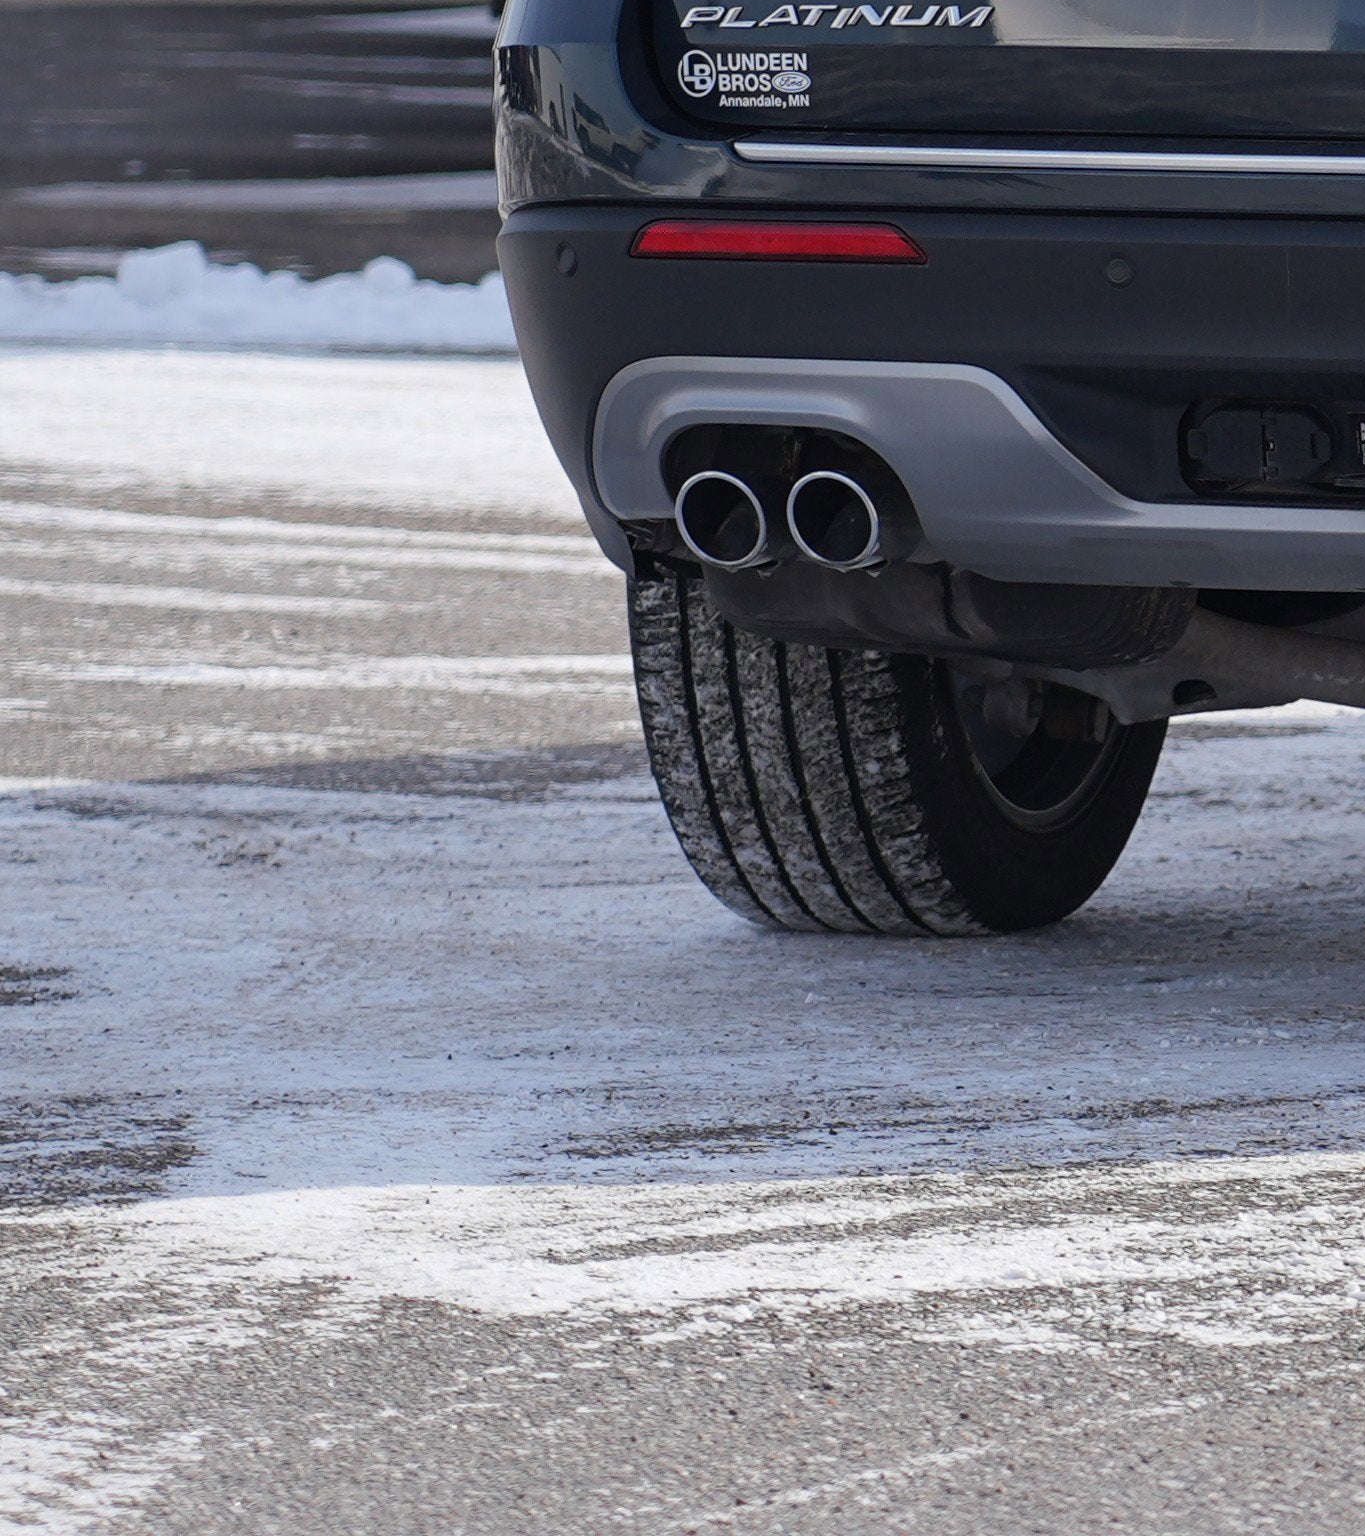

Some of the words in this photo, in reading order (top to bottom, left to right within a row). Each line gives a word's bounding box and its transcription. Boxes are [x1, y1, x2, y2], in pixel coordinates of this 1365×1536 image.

[680, 4, 995, 29] PLATINUM
[716, 53, 808, 71] LUNDEEN
[718, 73, 772, 92] BROS
[719, 94, 787, 109] Annandale,
[788, 94, 810, 107] MN
